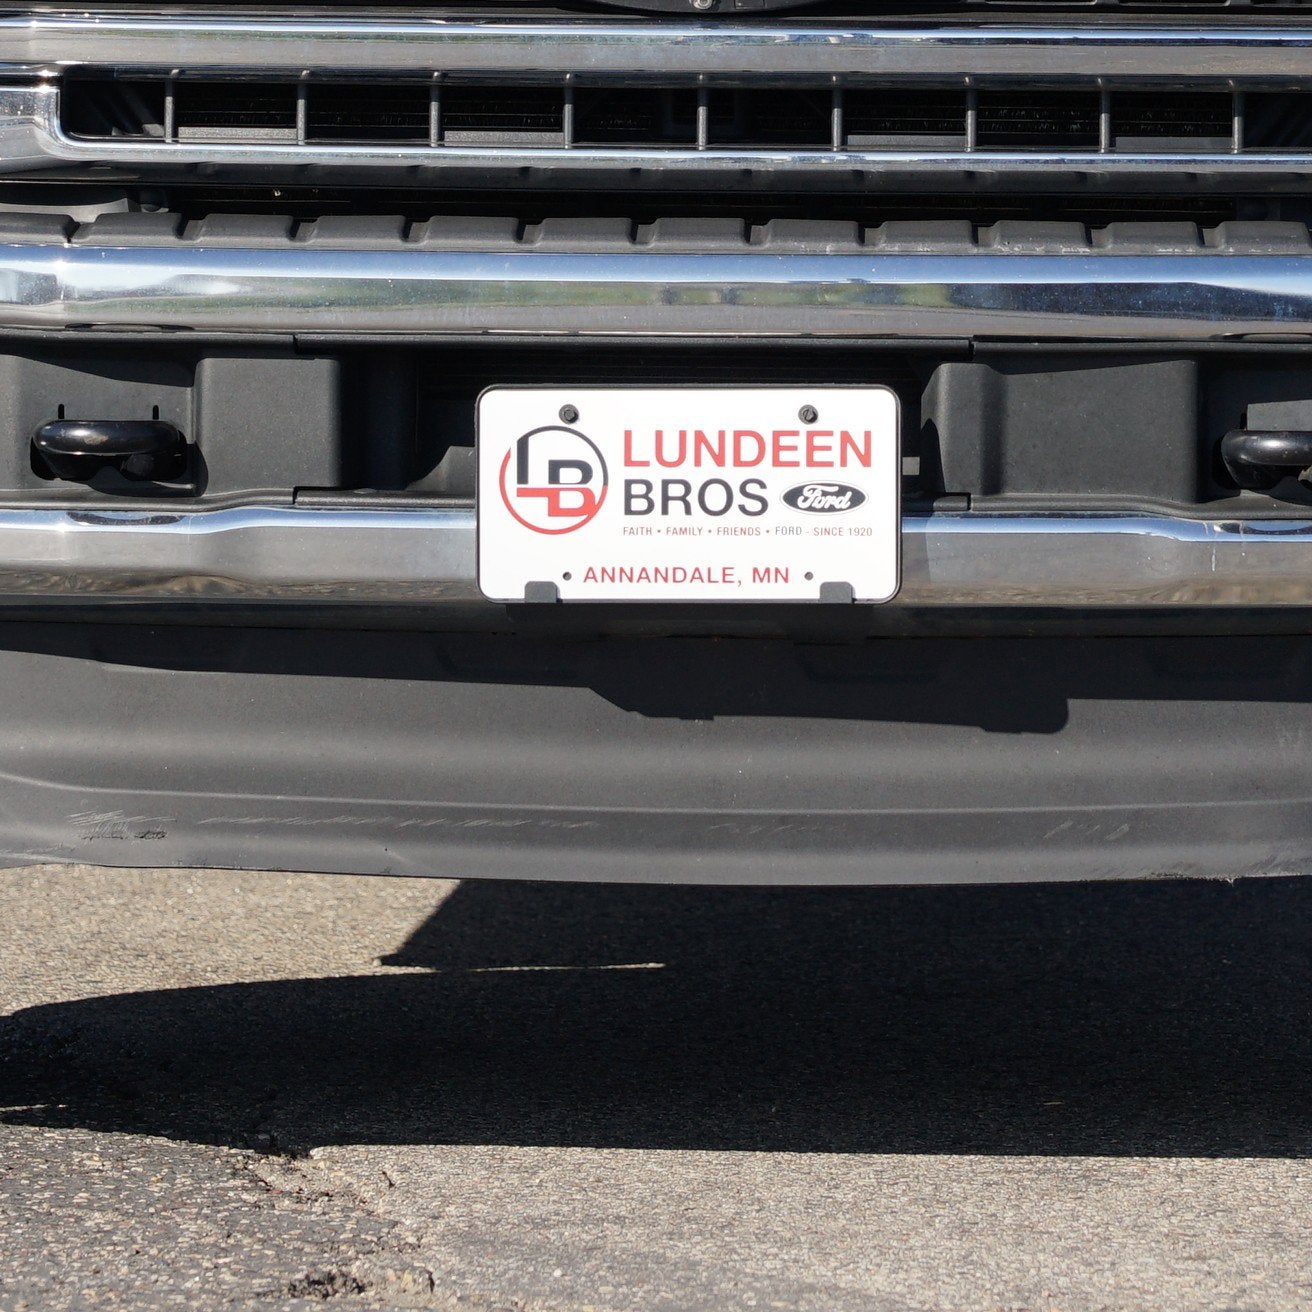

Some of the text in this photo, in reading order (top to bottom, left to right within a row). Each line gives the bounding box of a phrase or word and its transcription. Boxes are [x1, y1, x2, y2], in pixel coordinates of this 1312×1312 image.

[623, 429, 872, 468] LUNDEEN
[623, 478, 769, 517] BROS
[797, 485, 852, 511] Ford
[622, 526, 873, 537] FAITH FAMILY FRIENDS FORD SINCE 1920
[583, 566, 790, 587] ANNANDALE, MN
